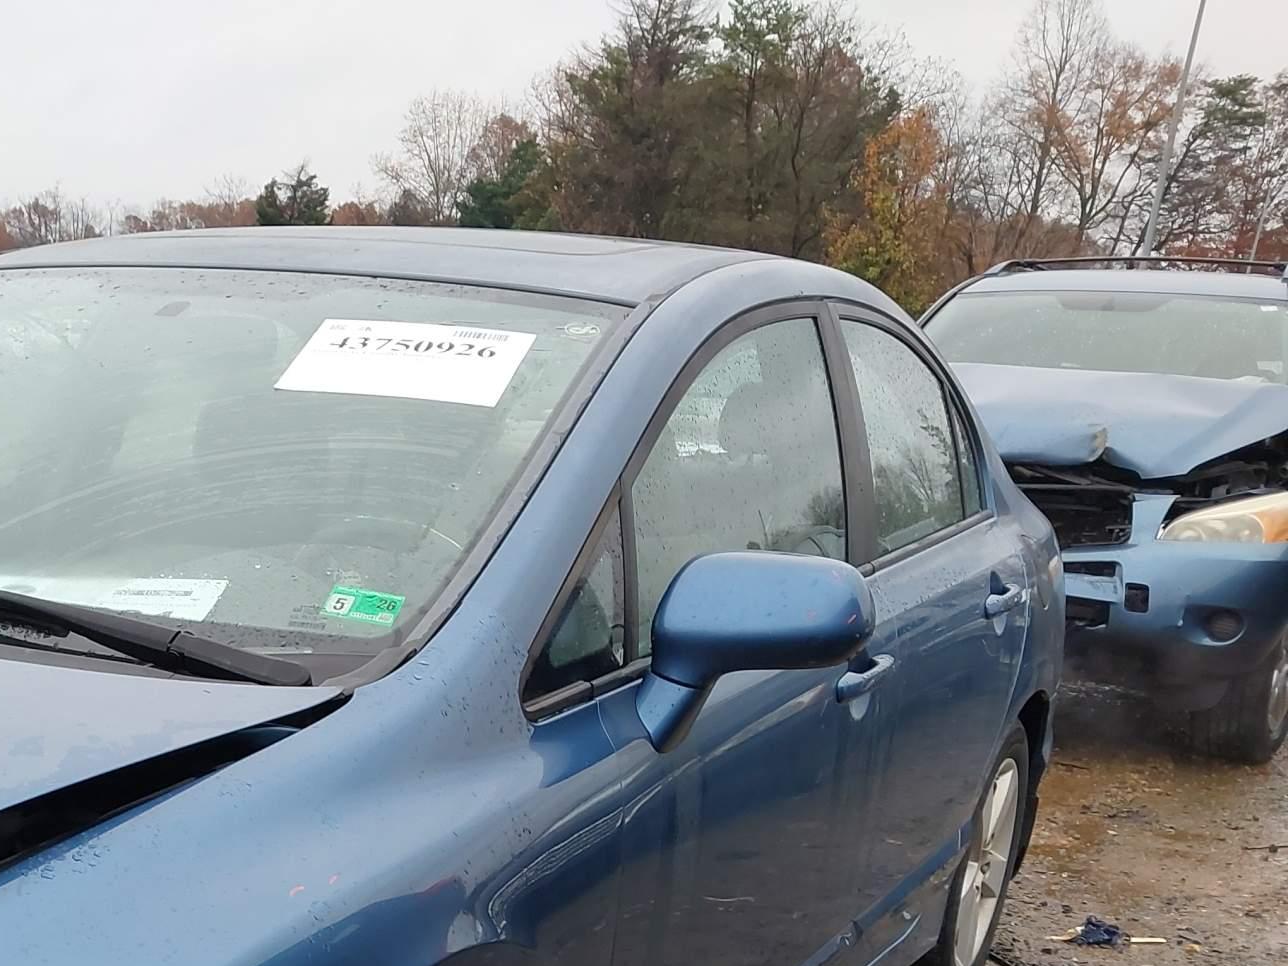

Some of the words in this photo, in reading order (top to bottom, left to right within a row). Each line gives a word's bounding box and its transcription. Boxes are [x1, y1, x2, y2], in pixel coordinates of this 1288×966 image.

[329, 336, 497, 358] 43750926
[333, 597, 348, 611] 5
[375, 598, 398, 612] 26
